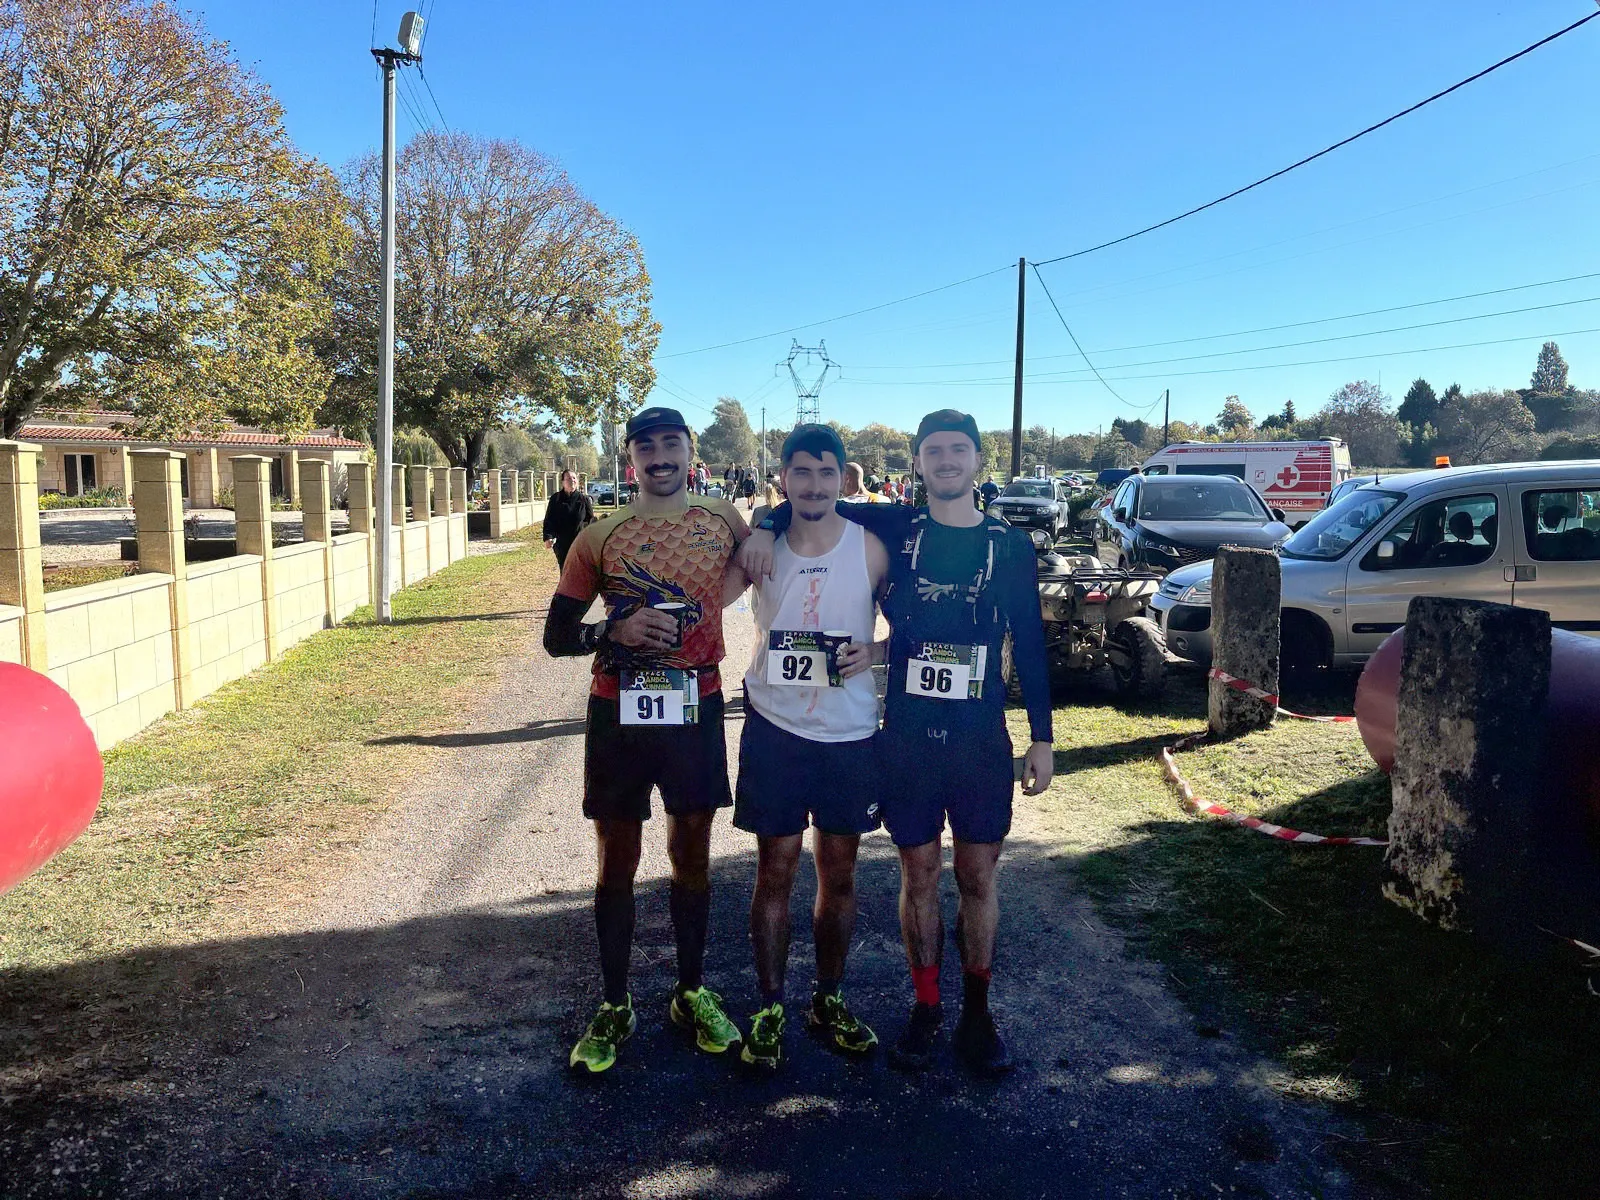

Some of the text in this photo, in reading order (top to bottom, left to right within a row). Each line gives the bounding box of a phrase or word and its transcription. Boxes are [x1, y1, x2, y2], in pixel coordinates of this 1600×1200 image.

[782, 655, 813, 681] 92
[920, 666, 953, 693] 96
[637, 695, 665, 720] 91
